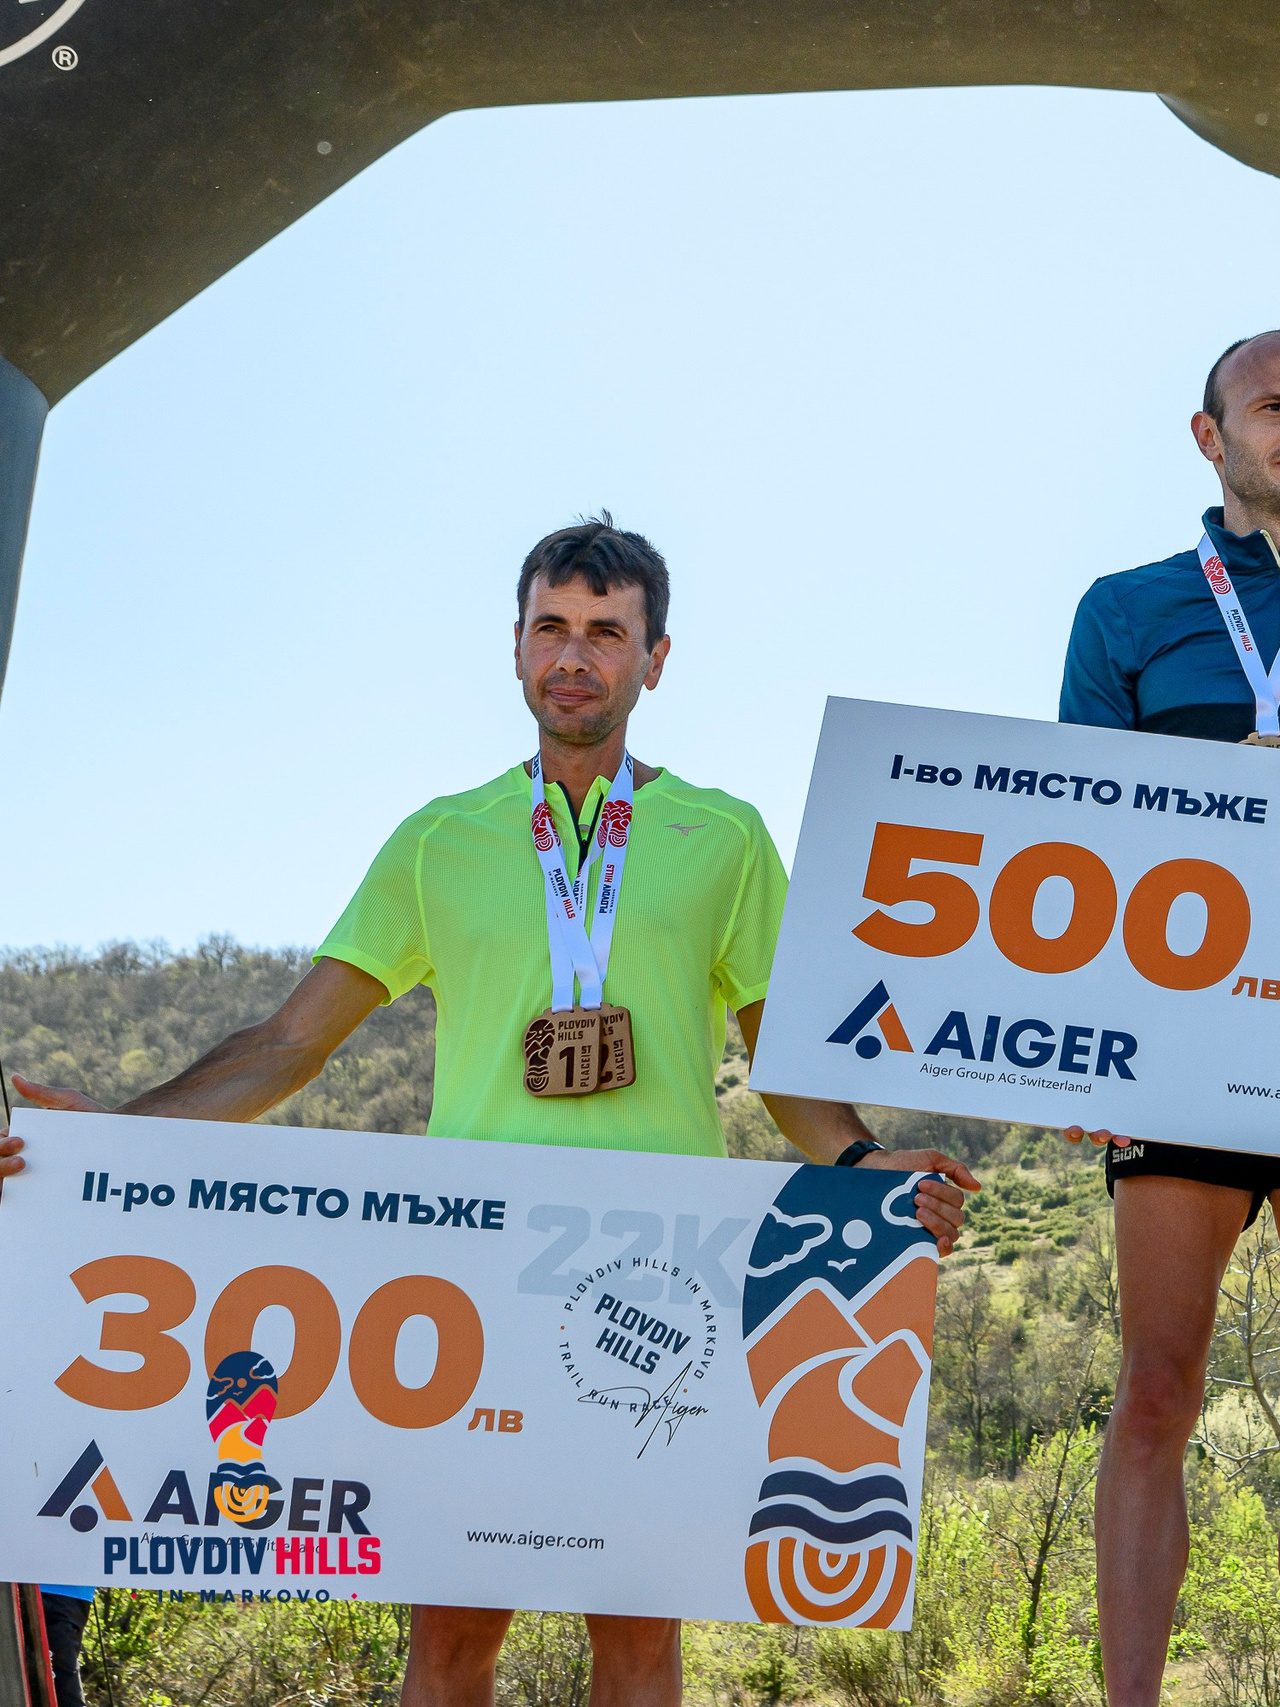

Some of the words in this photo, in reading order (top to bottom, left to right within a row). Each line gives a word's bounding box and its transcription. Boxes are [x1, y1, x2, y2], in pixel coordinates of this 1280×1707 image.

[974, 764, 1122, 805] МЯСТО
[1132, 784, 1269, 824] МЪЖЕ
[553, 867, 570, 898] PLOVDIV
[562, 898, 576, 920] HILLS
[599, 884, 612, 914] PLOVDIV
[604, 863, 615, 883] HILLS
[851, 821, 1252, 991] 500
[557, 1031, 584, 1041] HILLS
[558, 1019, 596, 1030] PLOVDIV
[923, 1010, 1138, 1081] AIGER
[559, 1046, 575, 1088] 1
[580, 1057, 590, 1087] PLACE
[920, 1062, 953, 1077] Aiger
[956, 1067, 995, 1083] Group
[998, 1072, 1016, 1085] AG
[1019, 1075, 1092, 1094] Switzerland
[188, 1178, 349, 1219] МЯСТО
[361, 1191, 507, 1231] МЪЖЕ
[517, 1204, 752, 1309] 22K
[54, 1254, 485, 1430] 300
[564, 1259, 622, 1312] PLOVDIV
[633, 1257, 680, 1277] HILLS
[685, 1277, 701, 1293] IN
[694, 1300, 717, 1379] MARKOVO
[594, 1292, 692, 1355] PLOVDIV
[559, 1342, 584, 1388] TRAIL
[588, 1389, 619, 1411] RUN
[595, 1327, 661, 1375] HILLS
[467, 1530, 605, 1550] www.aiger.com
